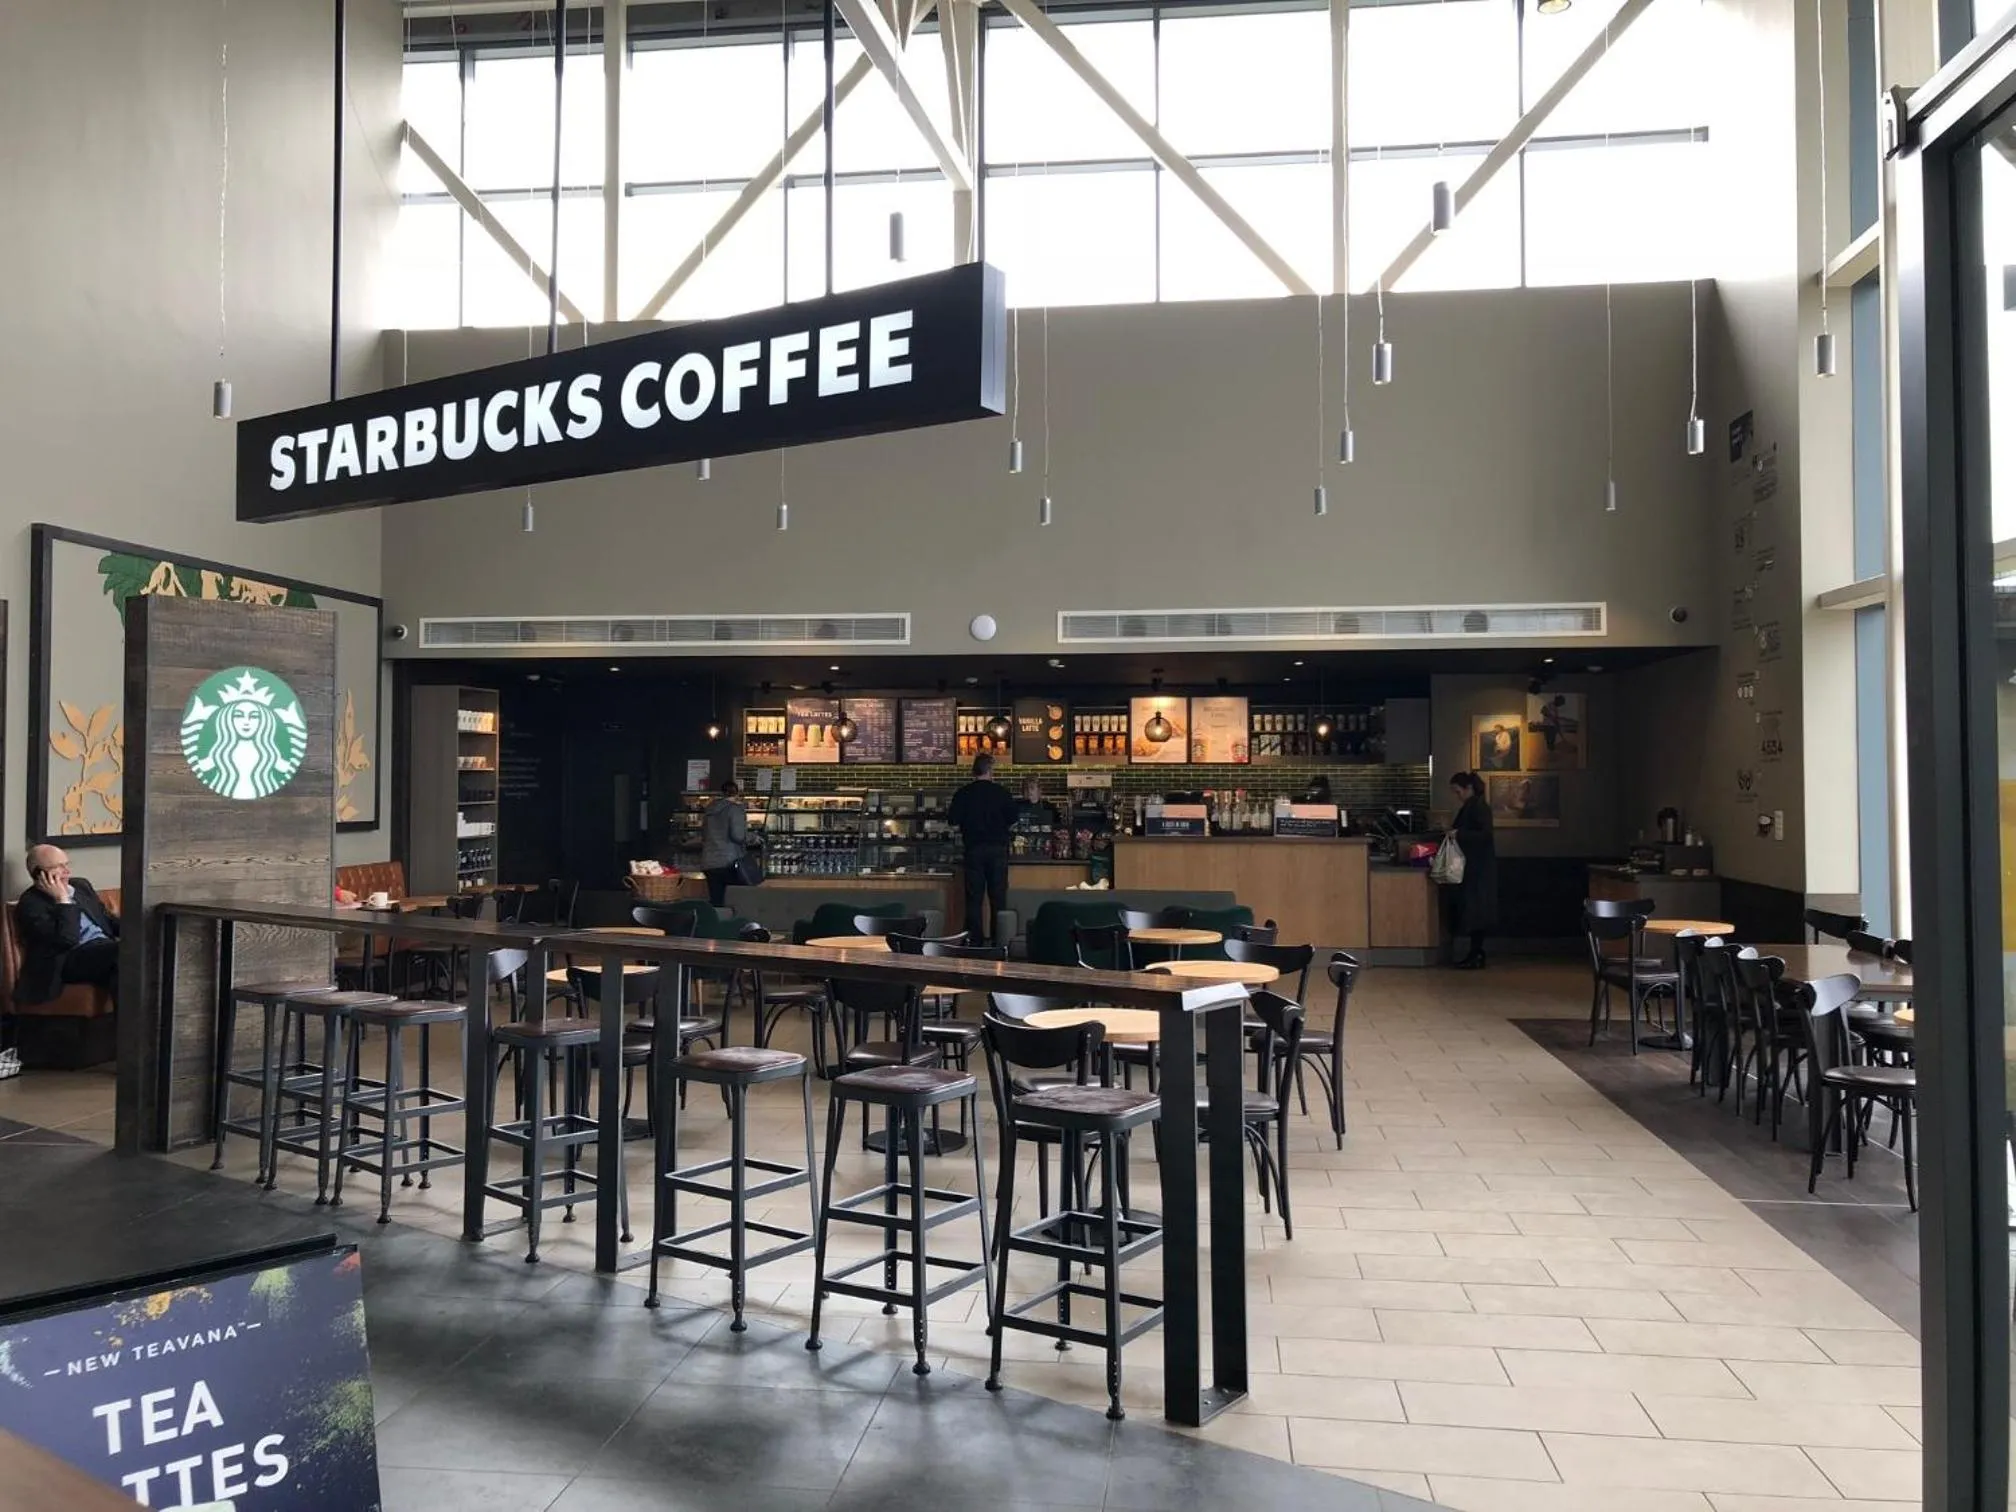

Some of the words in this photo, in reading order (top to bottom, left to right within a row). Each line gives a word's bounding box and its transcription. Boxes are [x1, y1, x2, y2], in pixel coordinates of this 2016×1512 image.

[269, 373, 603, 491] STARBUCKS
[620, 309, 914, 429] COFFEE
[67, 1351, 120, 1376] NEW
[92, 1380, 224, 1455] TEA
[121, 1433, 289, 1507] TTES
